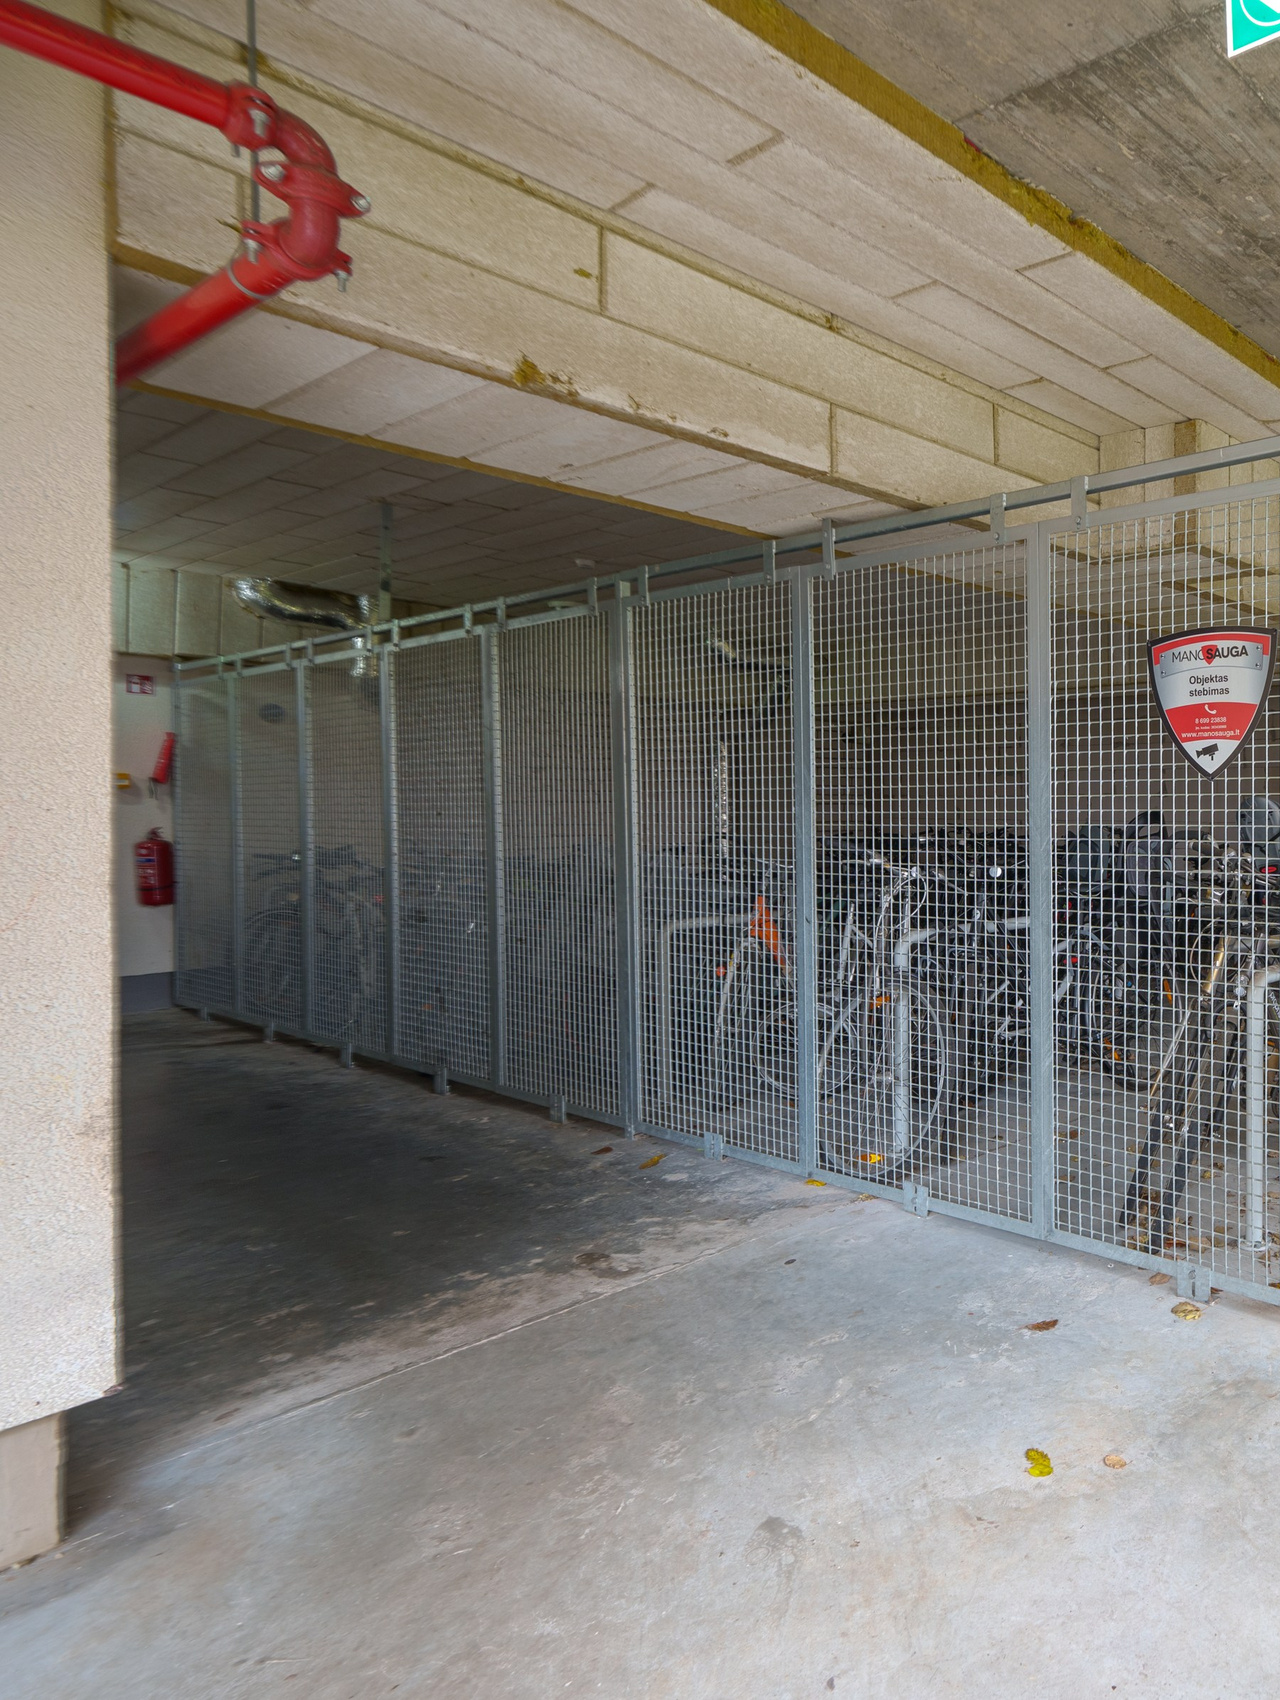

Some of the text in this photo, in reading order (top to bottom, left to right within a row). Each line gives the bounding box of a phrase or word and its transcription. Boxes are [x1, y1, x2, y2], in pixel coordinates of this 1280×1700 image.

[1189, 675, 1229, 686] Objektas
[1189, 687, 1230, 697] stebimas
[1181, 729, 1240, 738] www.manosauga.lt
